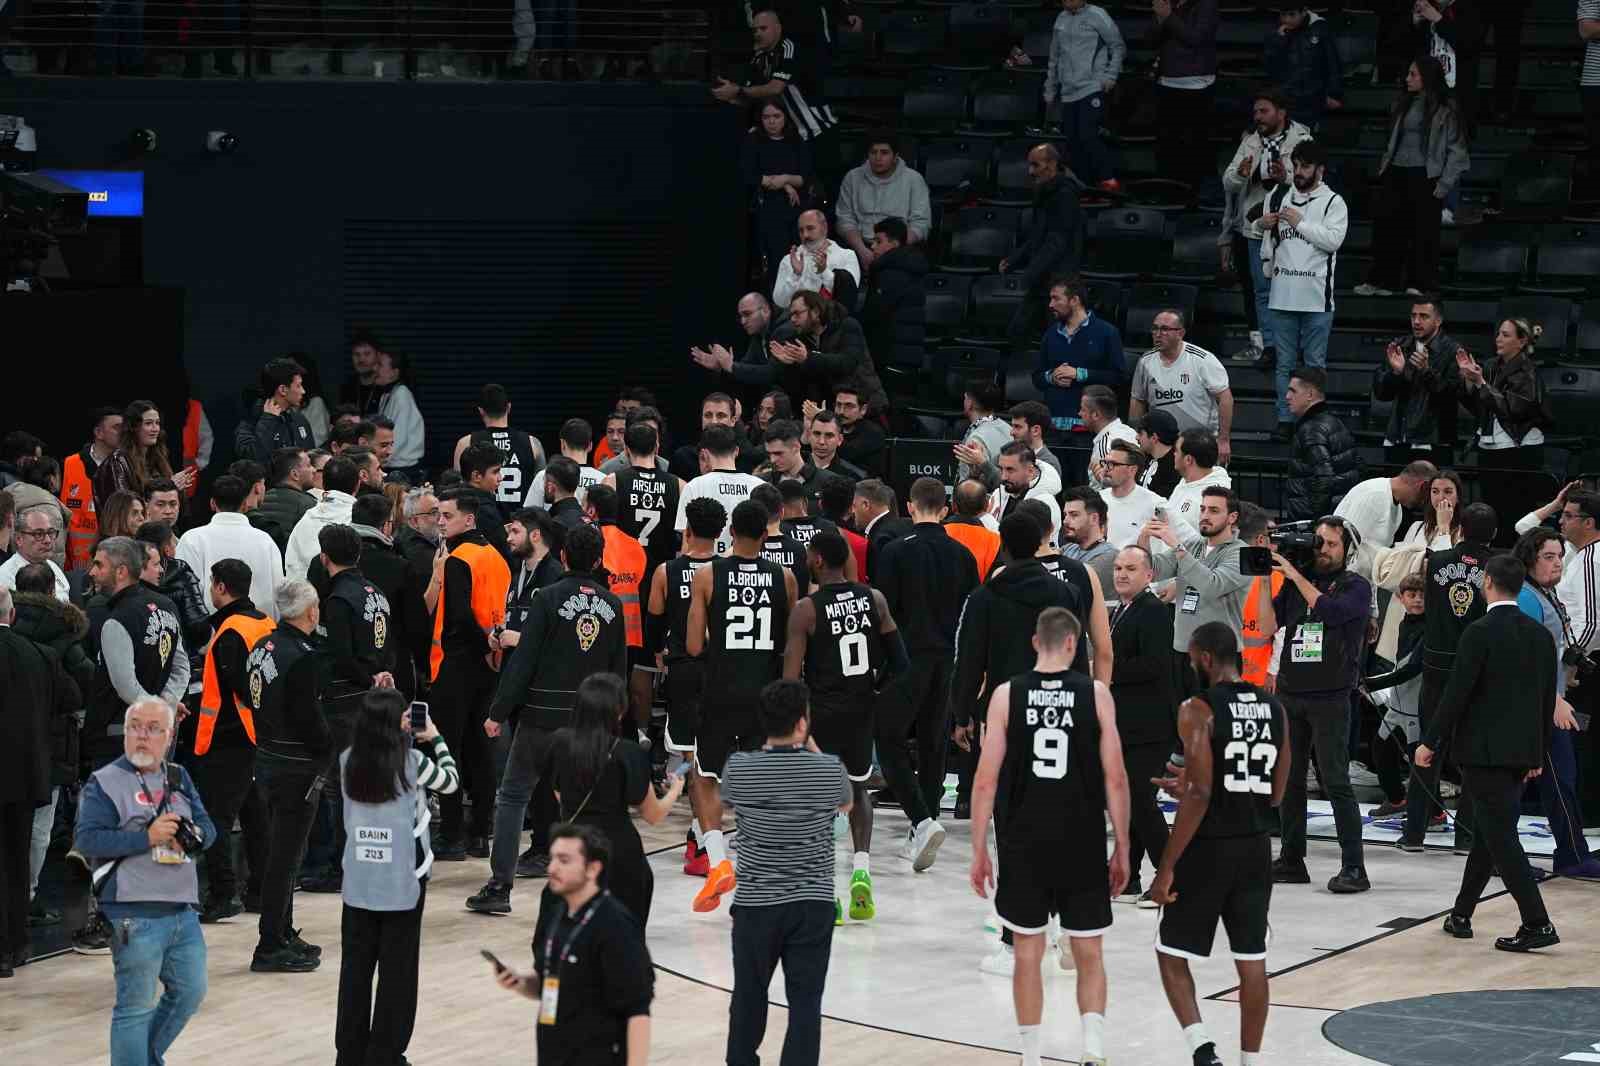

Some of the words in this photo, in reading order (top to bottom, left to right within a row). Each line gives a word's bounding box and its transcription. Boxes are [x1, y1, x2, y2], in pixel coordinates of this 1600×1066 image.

[1155, 388, 1183, 399] beko
[909, 464, 941, 475] BLOK
[632, 479, 666, 494] ARSLAN
[634, 508, 661, 546] 7
[728, 571, 773, 587] A.BROWN
[825, 596, 870, 619] MATHEWS
[725, 606, 774, 650] 21
[839, 632, 869, 677] 0
[1028, 689, 1075, 708] MORGAN
[1032, 727, 1069, 780] 9
